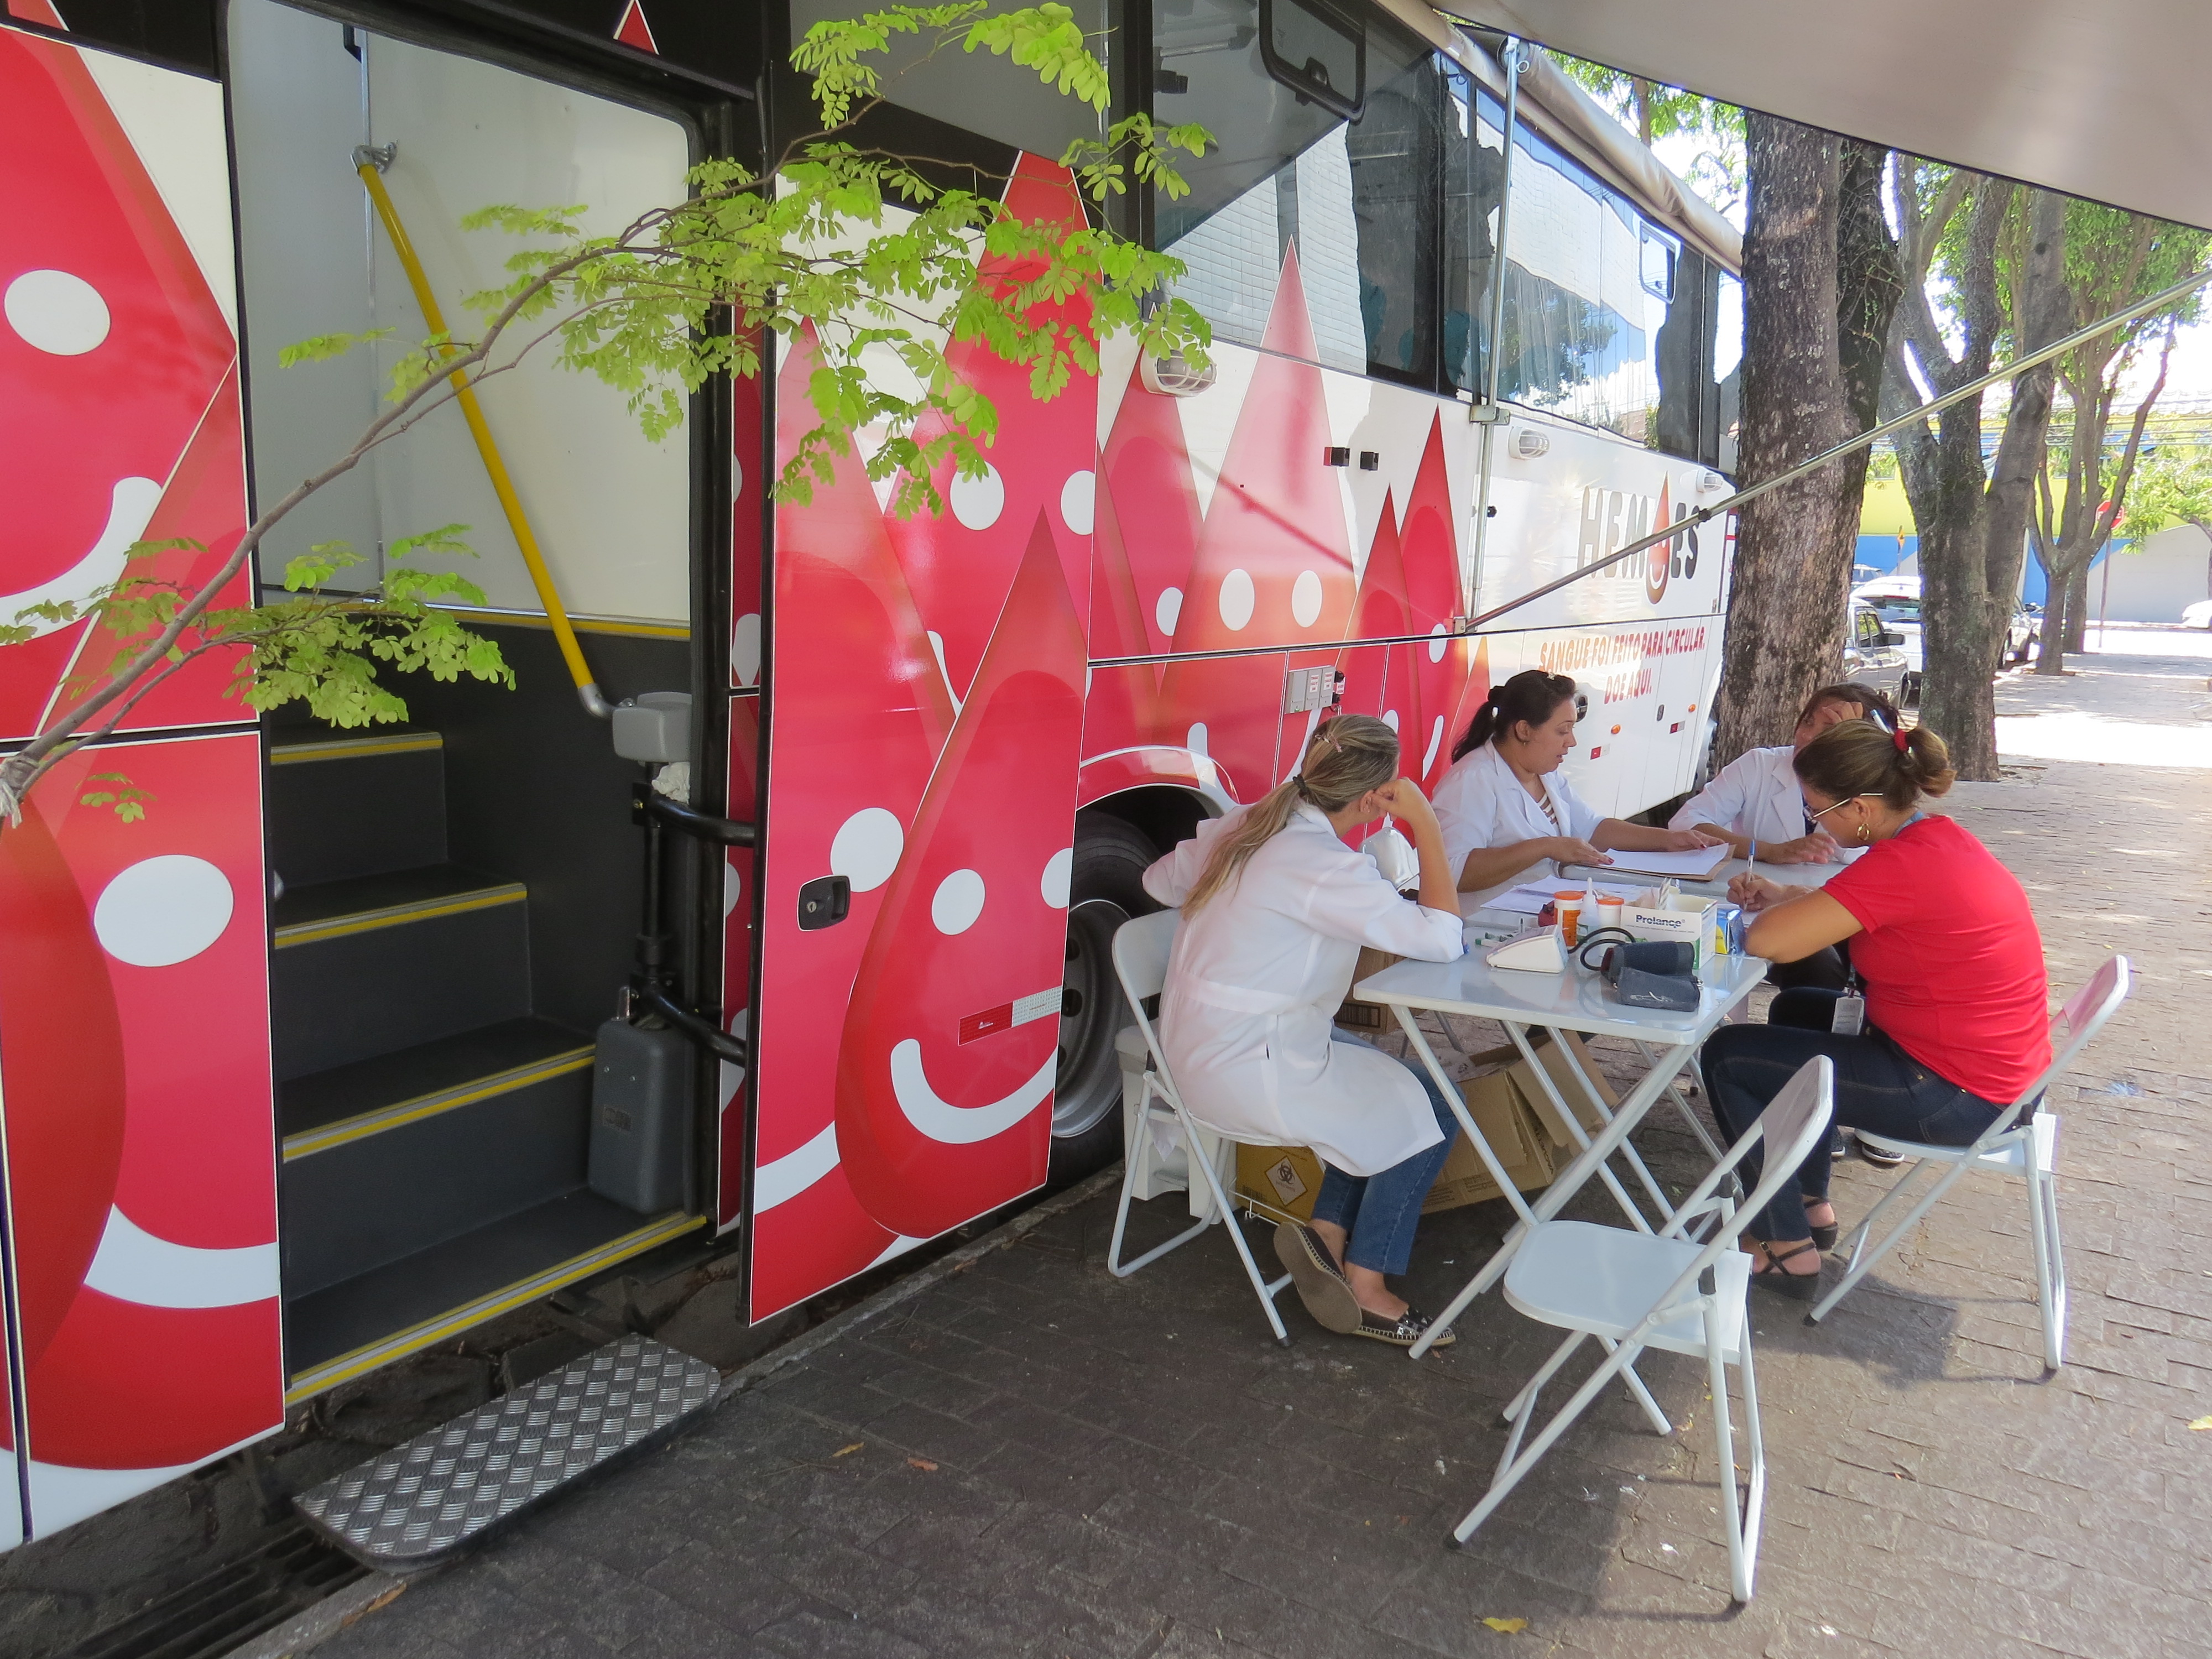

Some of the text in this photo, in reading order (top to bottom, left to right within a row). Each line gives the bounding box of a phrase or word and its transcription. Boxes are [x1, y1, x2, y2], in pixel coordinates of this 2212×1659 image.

[1538, 627, 1705, 673] SANGUE FOI FEITO PARA CIRCULAR.
[1604, 667, 1652, 705] DOE AQUI.
[1635, 914, 1682, 928] Prolance
